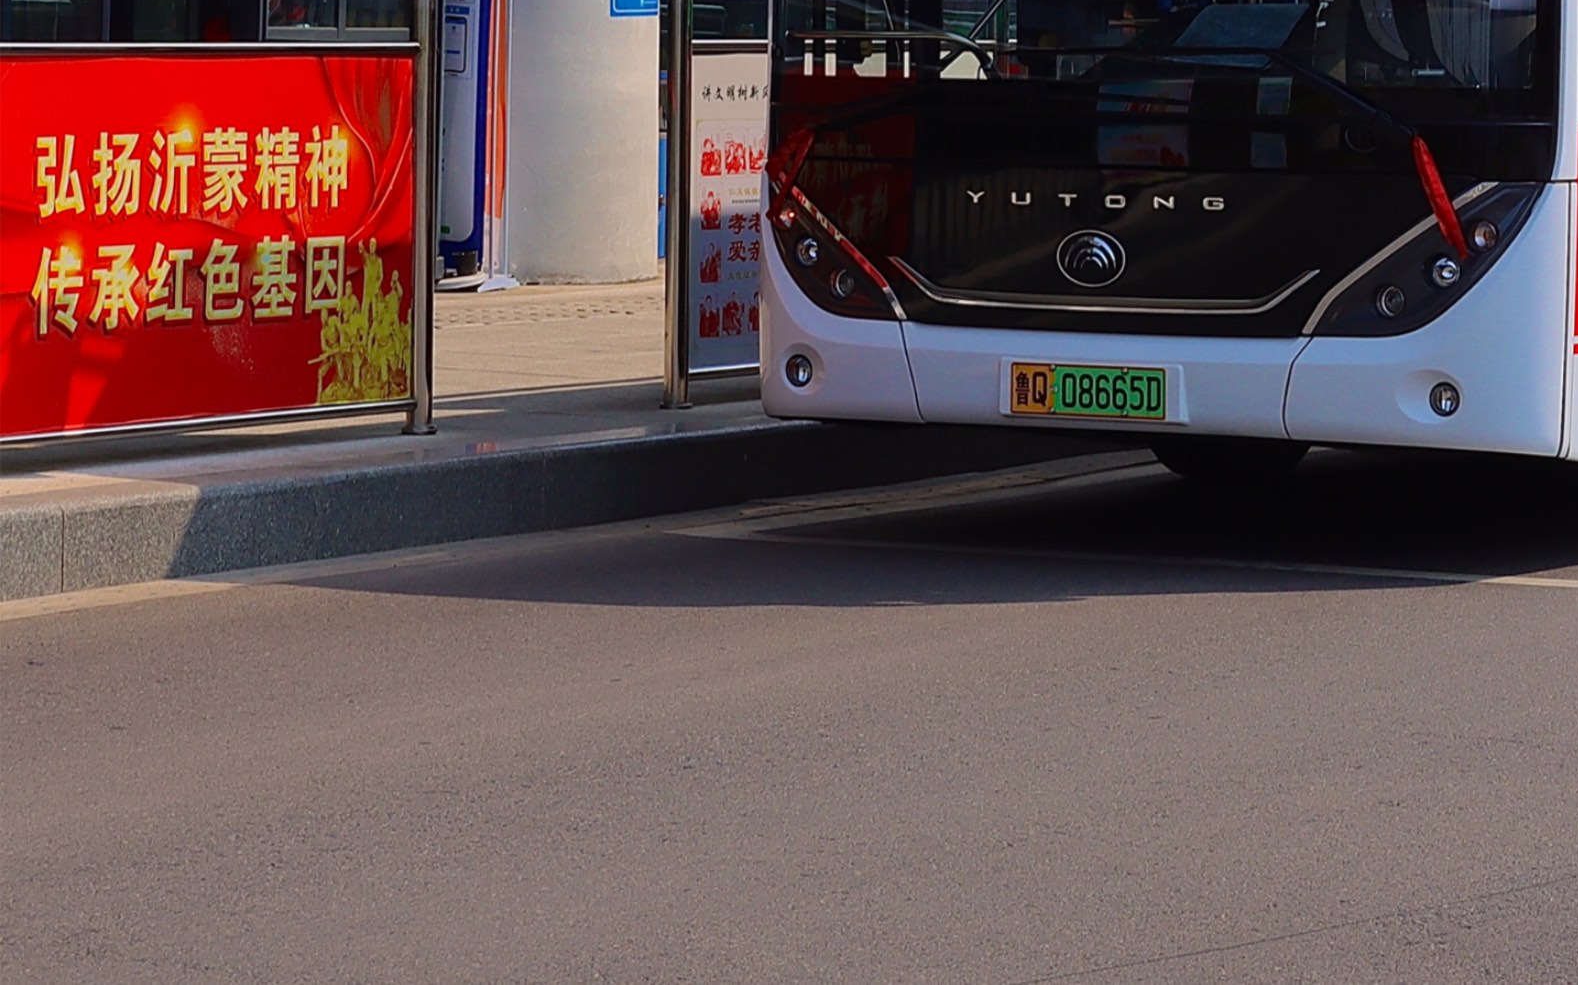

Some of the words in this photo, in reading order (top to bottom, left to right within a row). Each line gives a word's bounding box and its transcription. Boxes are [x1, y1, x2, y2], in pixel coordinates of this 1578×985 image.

[36, 125, 348, 218] 弘扬沂蒙精神
[966, 190, 1225, 211] YUTONG
[31, 234, 347, 335] 传承红色基因
